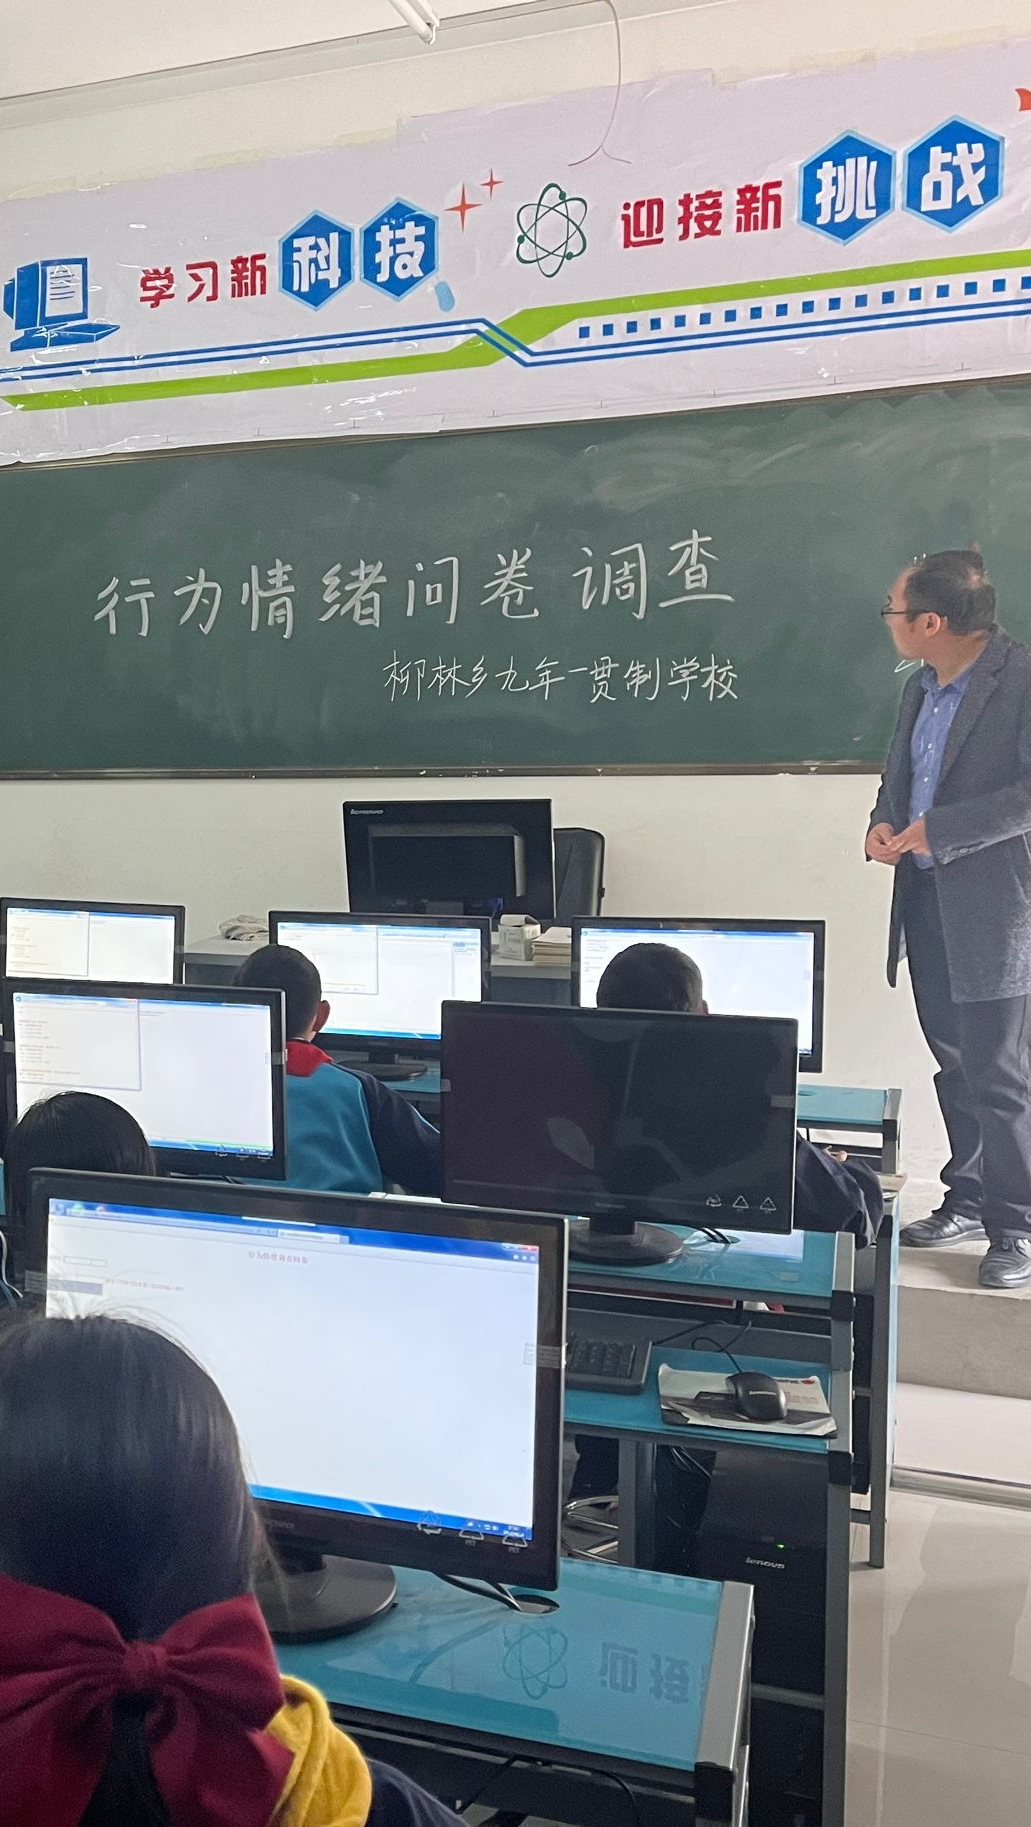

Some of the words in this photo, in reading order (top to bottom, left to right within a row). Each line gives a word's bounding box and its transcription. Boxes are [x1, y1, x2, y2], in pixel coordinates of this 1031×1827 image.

[620, 142, 986, 249] 迎接新挑战
[138, 221, 426, 309] 学习新科技
[93, 529, 735, 639] 行为情绪问卷调查
[382, 650, 739, 703] 柳林乡九年一贯制学校
[745, 1556, 785, 1569] lenovo
